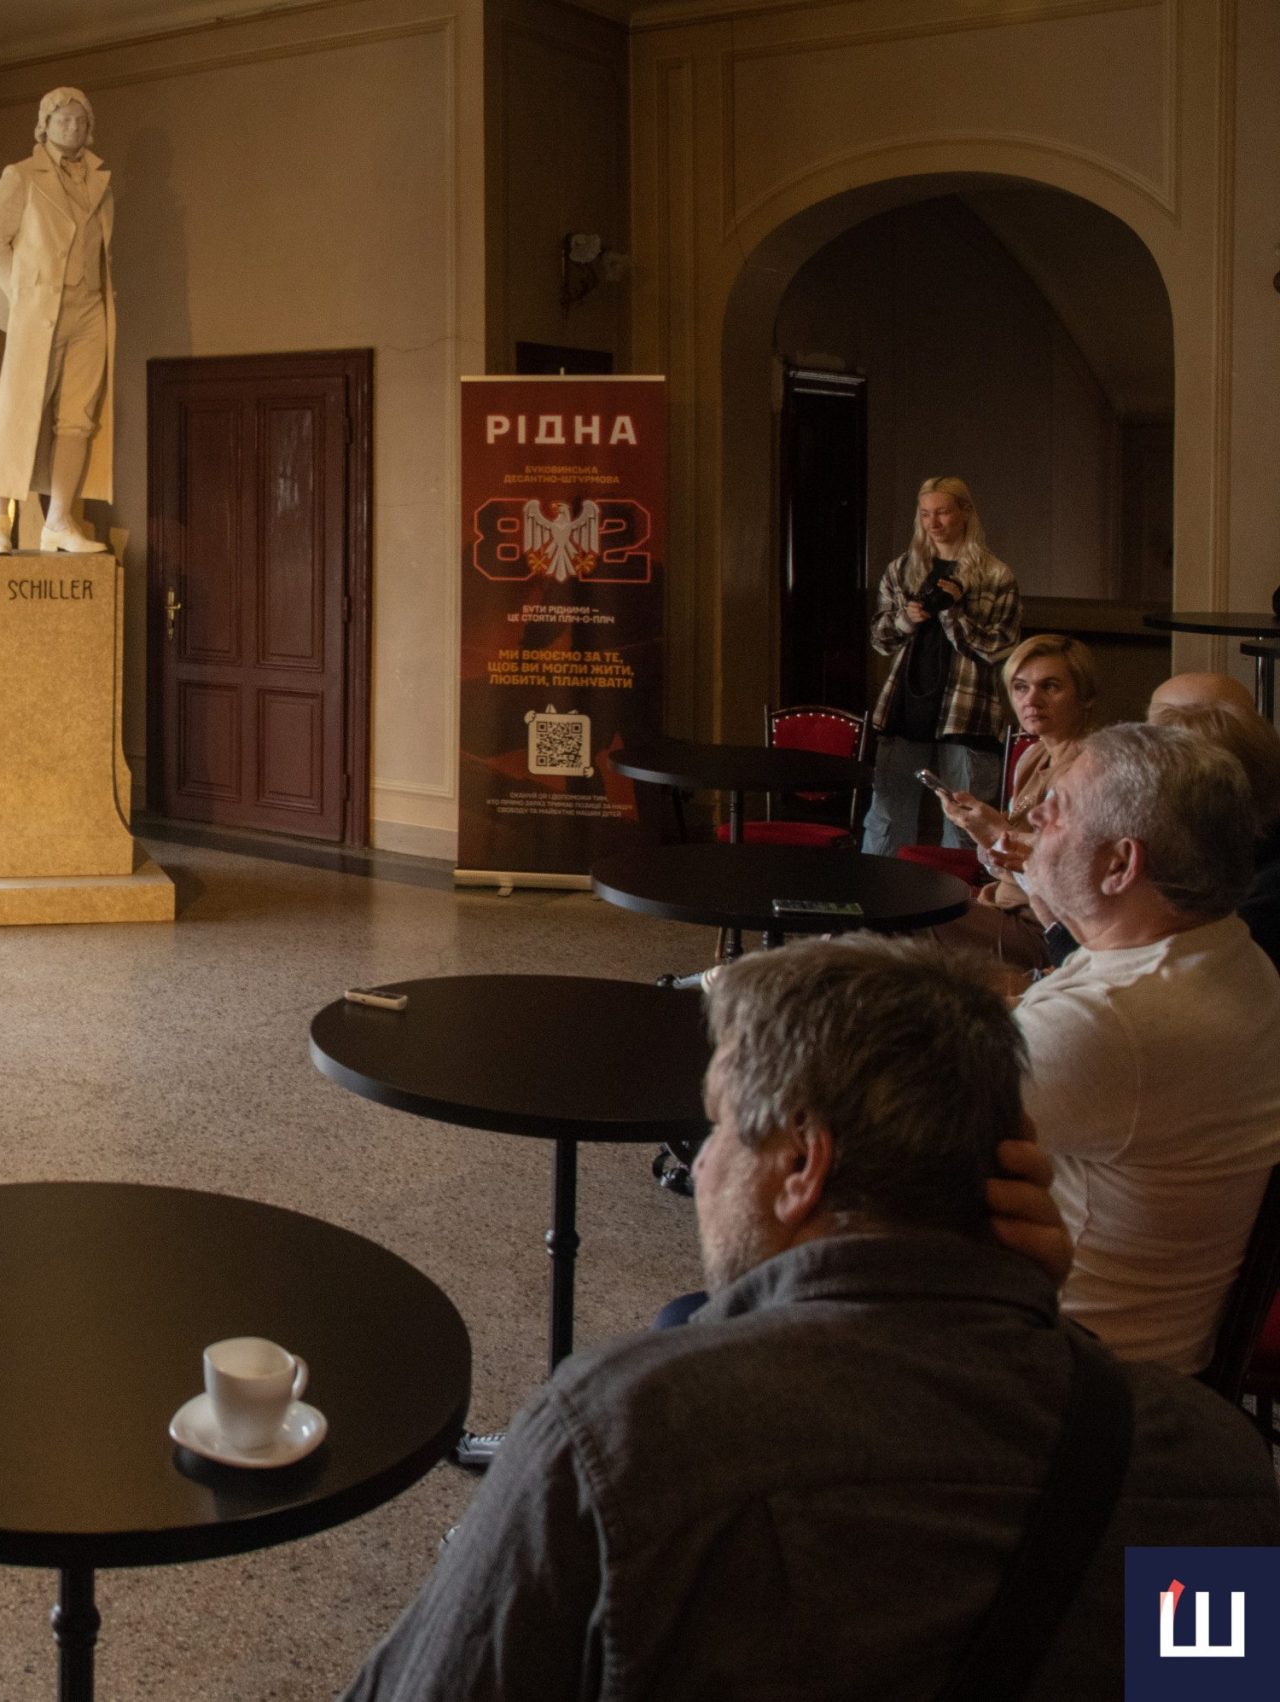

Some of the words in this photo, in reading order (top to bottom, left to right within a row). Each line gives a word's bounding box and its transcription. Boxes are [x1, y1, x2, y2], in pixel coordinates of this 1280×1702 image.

[486, 414, 638, 445] РІДНА
[524, 465, 599, 474] БУКОВИНСЬКА
[503, 474, 620, 484] ДЕСАНТНО-ШТУРМОВА
[7, 579, 94, 601] SCHILLER
[522, 604, 546, 613] БУТИ
[507, 613, 519, 622] ЦЕ
[521, 614, 557, 623] СТОЯТИ
[557, 615, 615, 624] ПЛІЧ-О-ПЛІЧ
[498, 649, 519, 660] МИ
[522, 650, 582, 662] ВОЮЄМО
[584, 651, 601, 662] ЗА
[604, 652, 624, 664] ТЕ,
[487, 662, 519, 674] ЩОБ
[521, 663, 539, 673] ВИ
[542, 663, 588, 675] МОГЛИ
[590, 664, 635, 677] ЖИТИ,
[489, 675, 550, 687] ЛЮБИТИ,
[552, 675, 633, 688] ПЛАНУВАТИ
